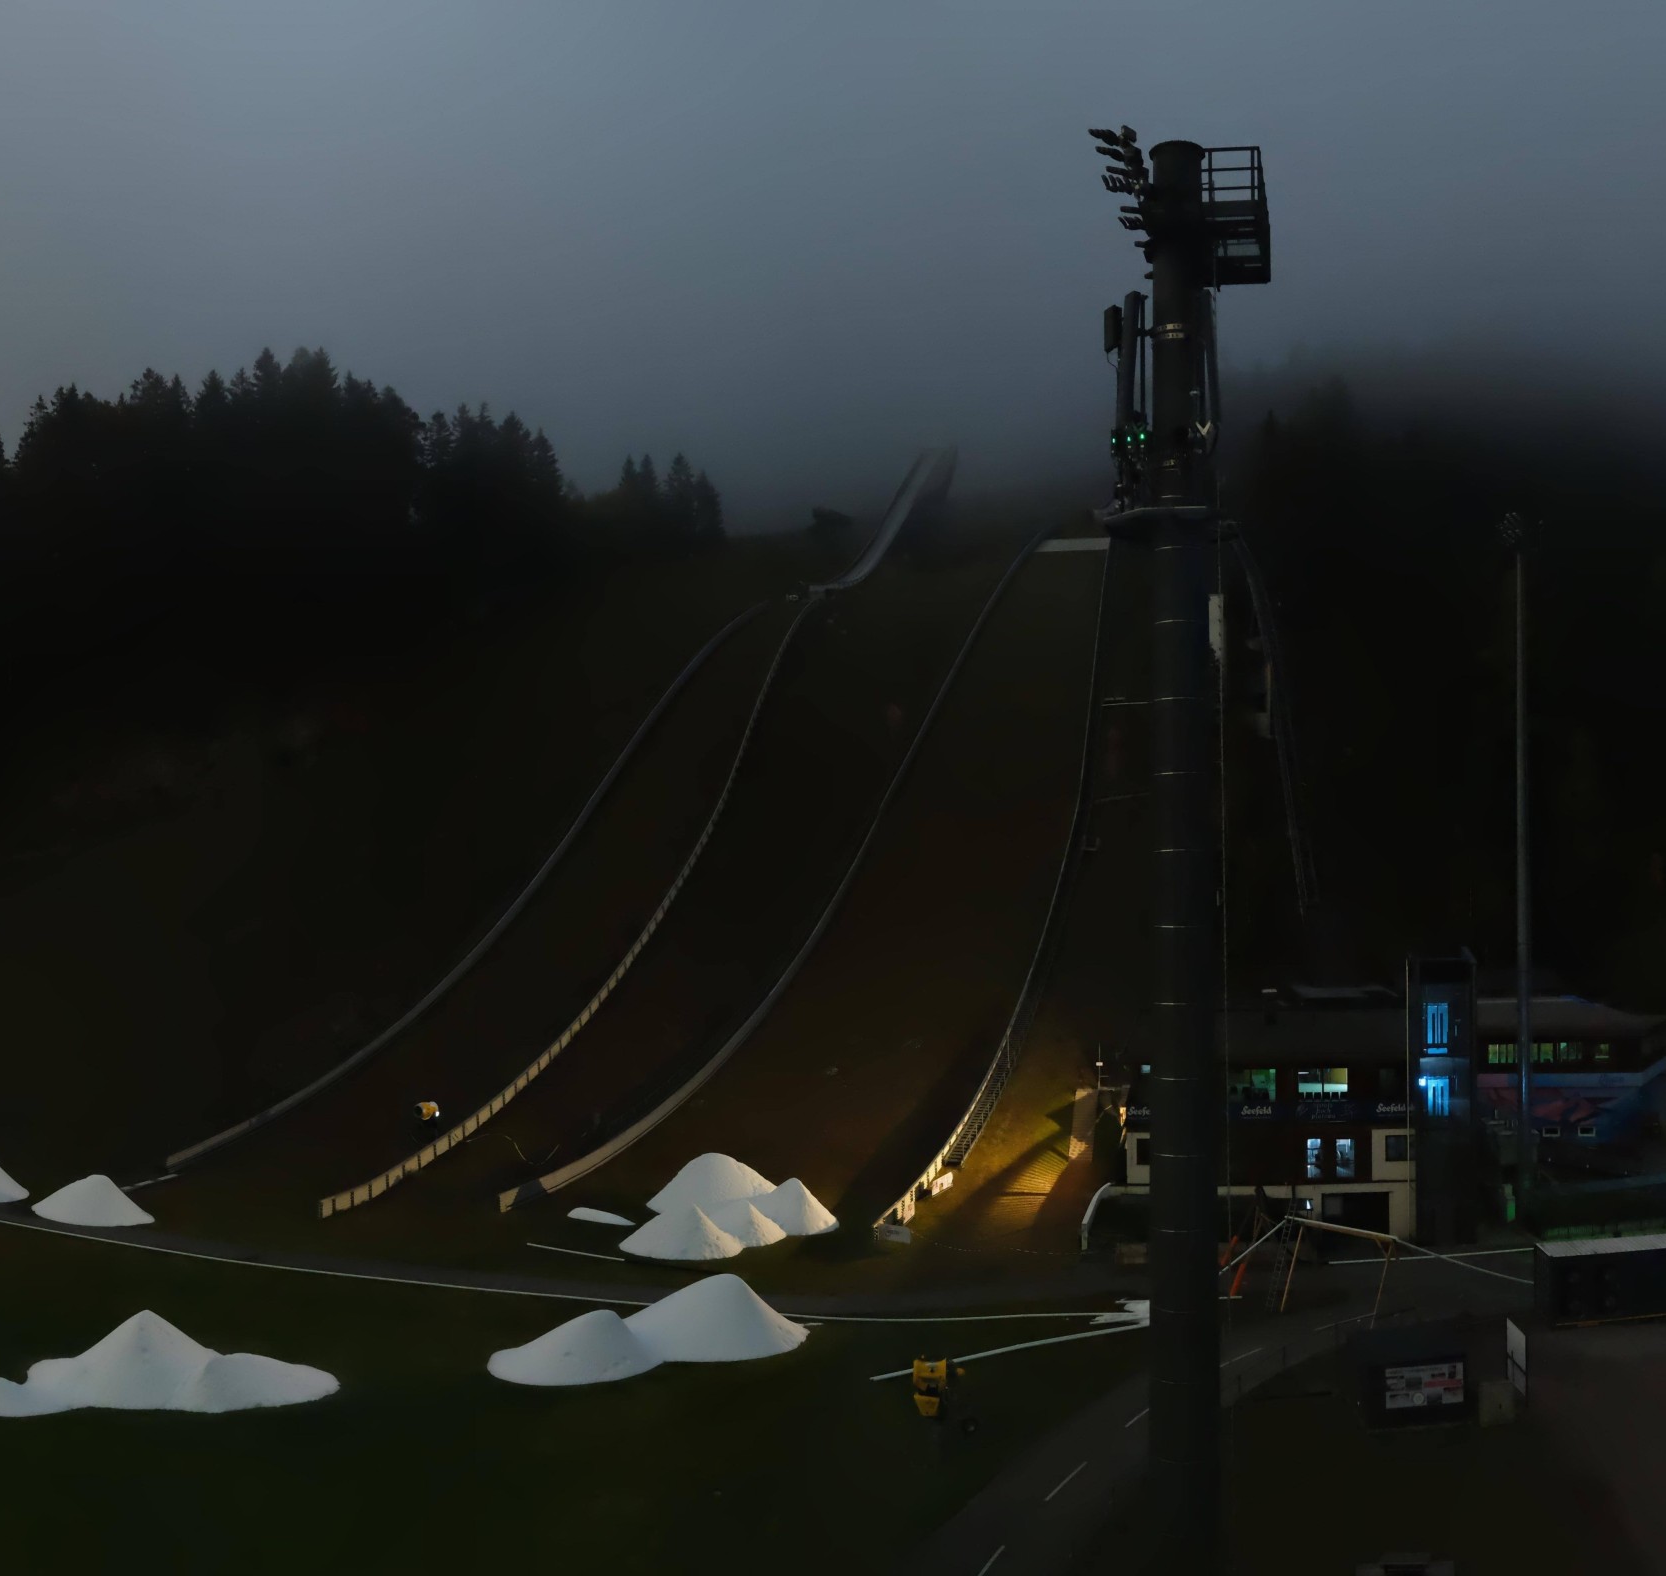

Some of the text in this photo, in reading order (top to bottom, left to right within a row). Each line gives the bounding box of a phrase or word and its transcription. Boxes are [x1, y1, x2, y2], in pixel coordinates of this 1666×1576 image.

[1127, 1106, 1151, 1117] Seefe
[1241, 1105, 1272, 1117] Seefeld
[1376, 1103, 1406, 1113] Seefeld
